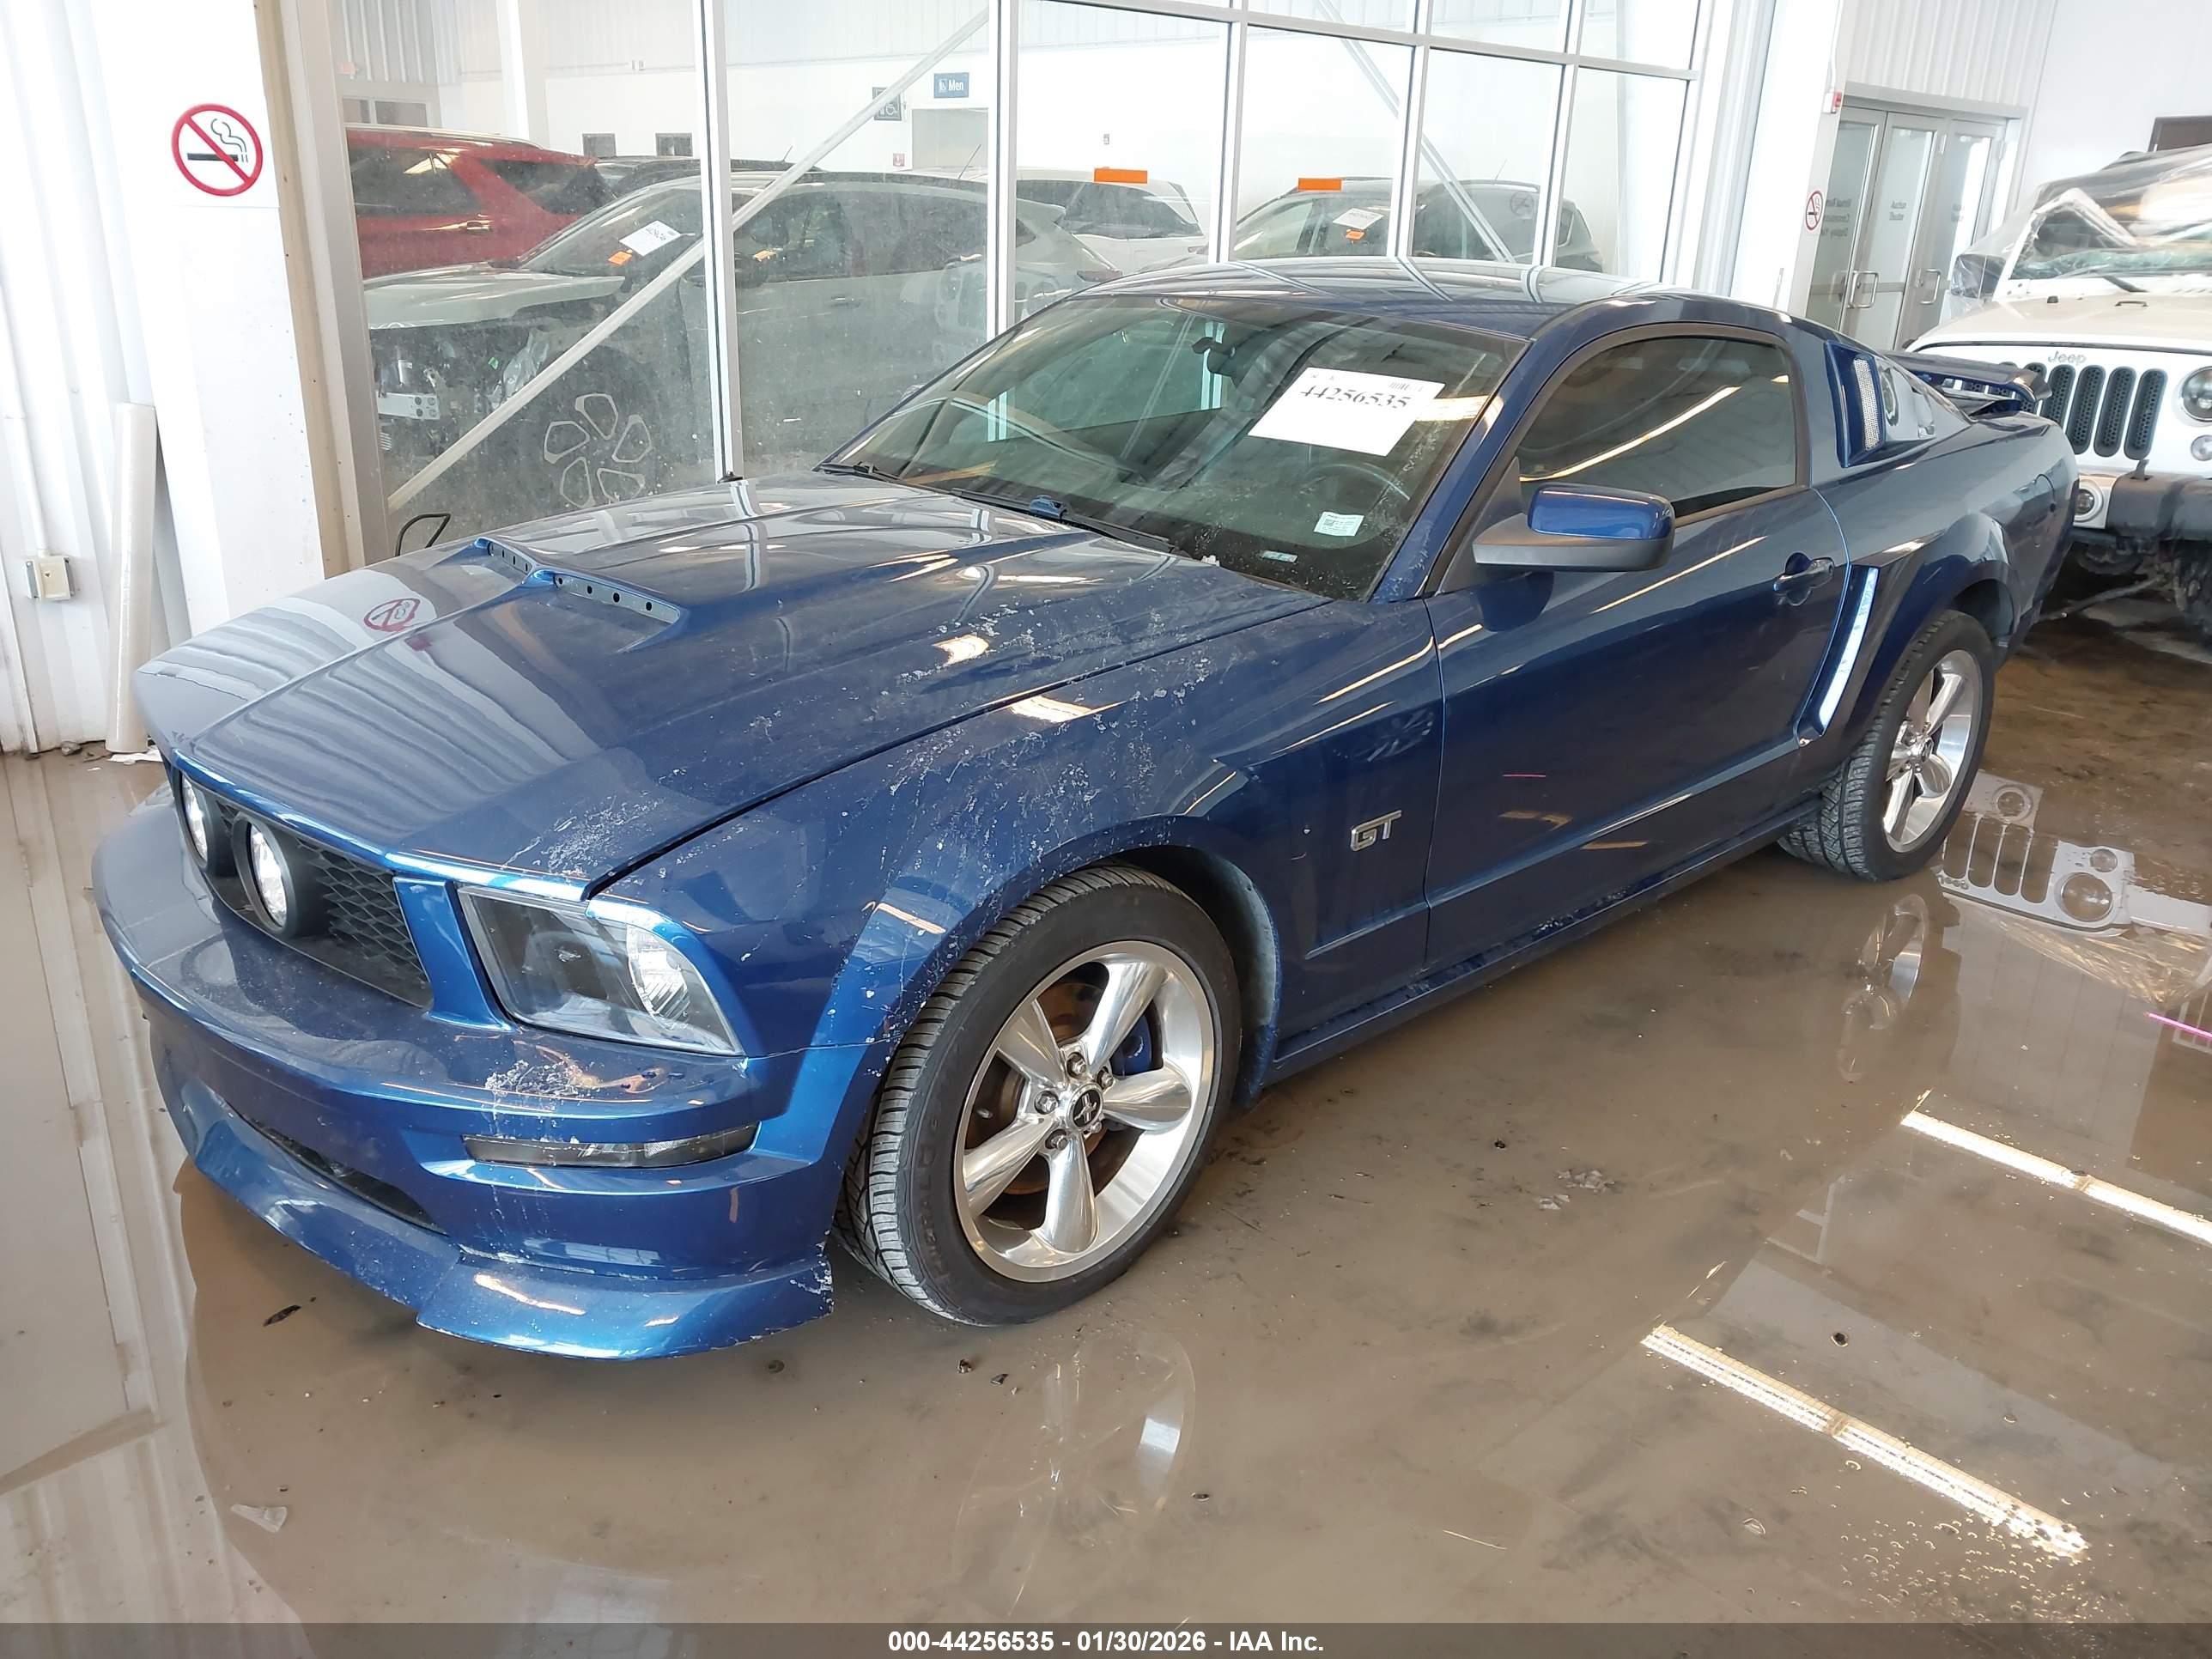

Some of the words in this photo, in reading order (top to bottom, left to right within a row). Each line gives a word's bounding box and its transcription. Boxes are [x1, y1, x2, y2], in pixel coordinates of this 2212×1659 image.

[948, 79, 963, 91] Men
[2048, 350, 2087, 366] Jeep
[1300, 385, 1412, 409] 44256535
[1350, 810, 1402, 851] GT
